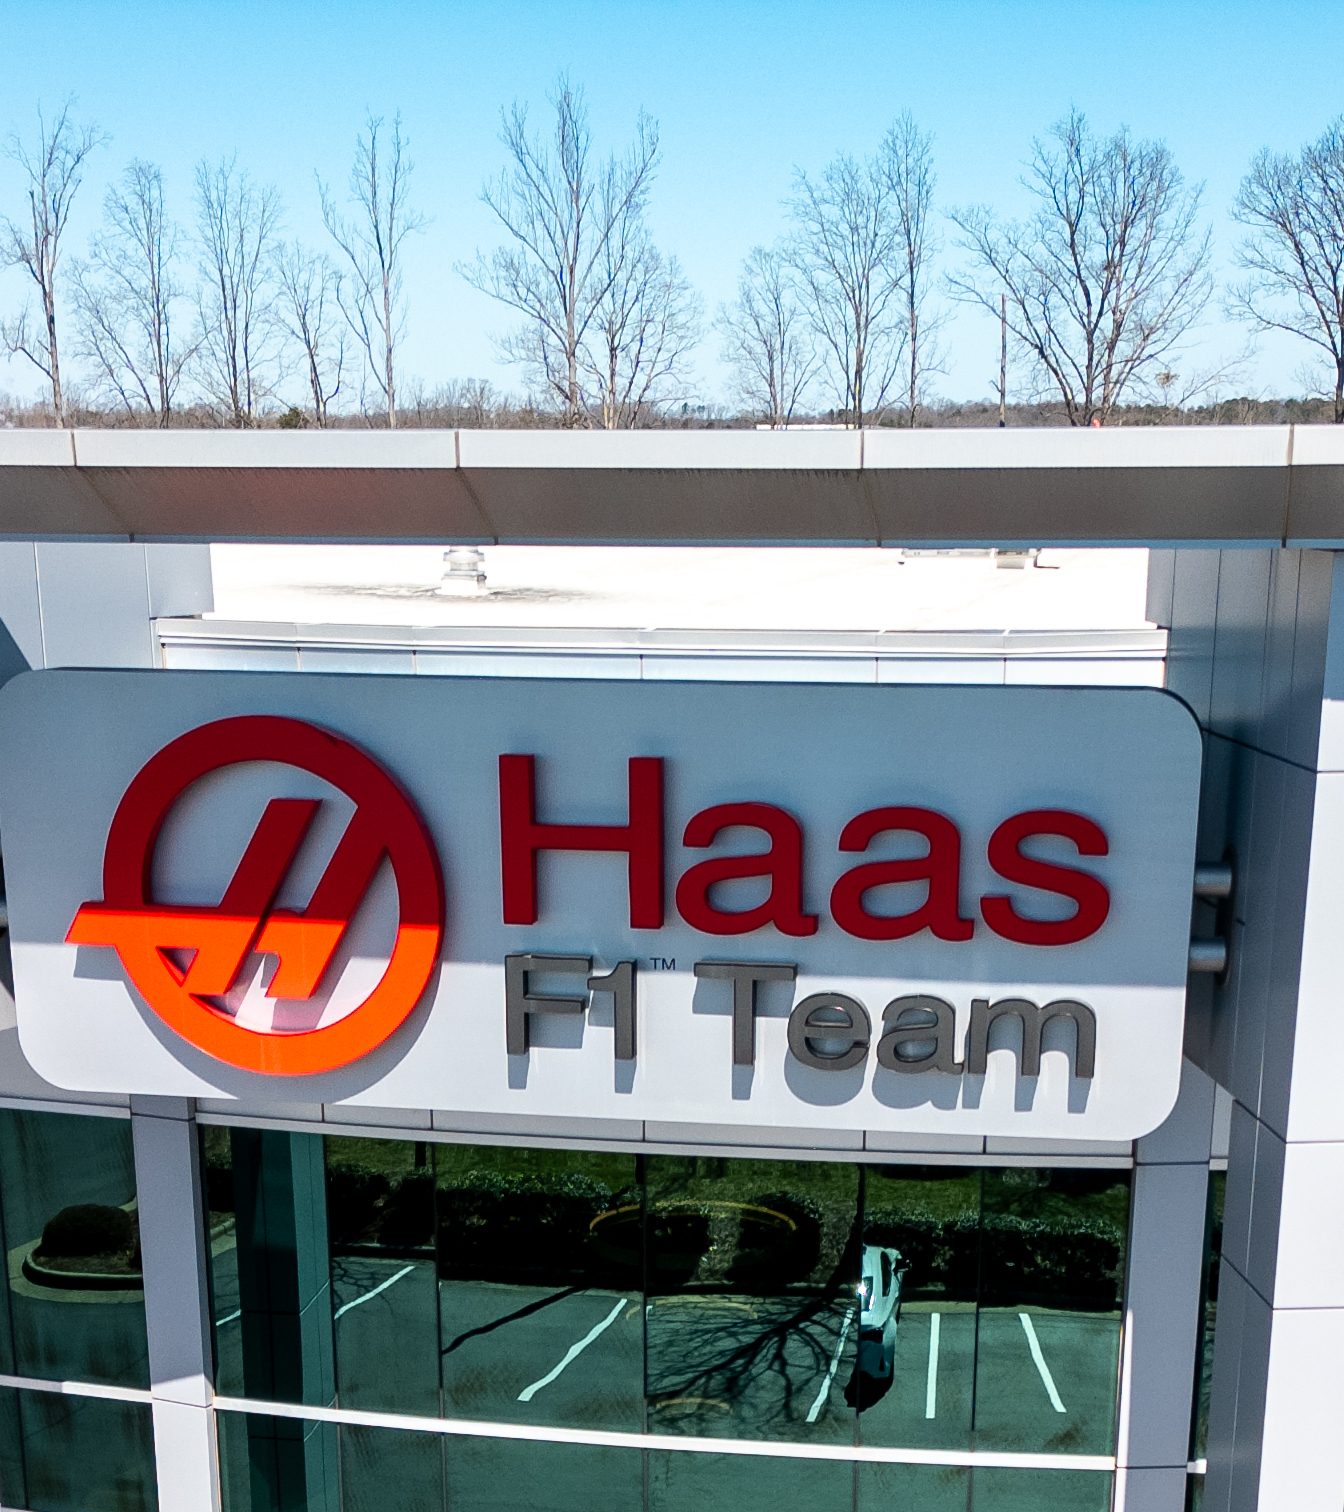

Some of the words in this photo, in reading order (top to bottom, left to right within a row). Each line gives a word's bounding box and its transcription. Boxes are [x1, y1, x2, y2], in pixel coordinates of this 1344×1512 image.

[497, 752, 1112, 947] Haas
[503, 952, 638, 1061] F1
[692, 961, 1098, 1079] Team
